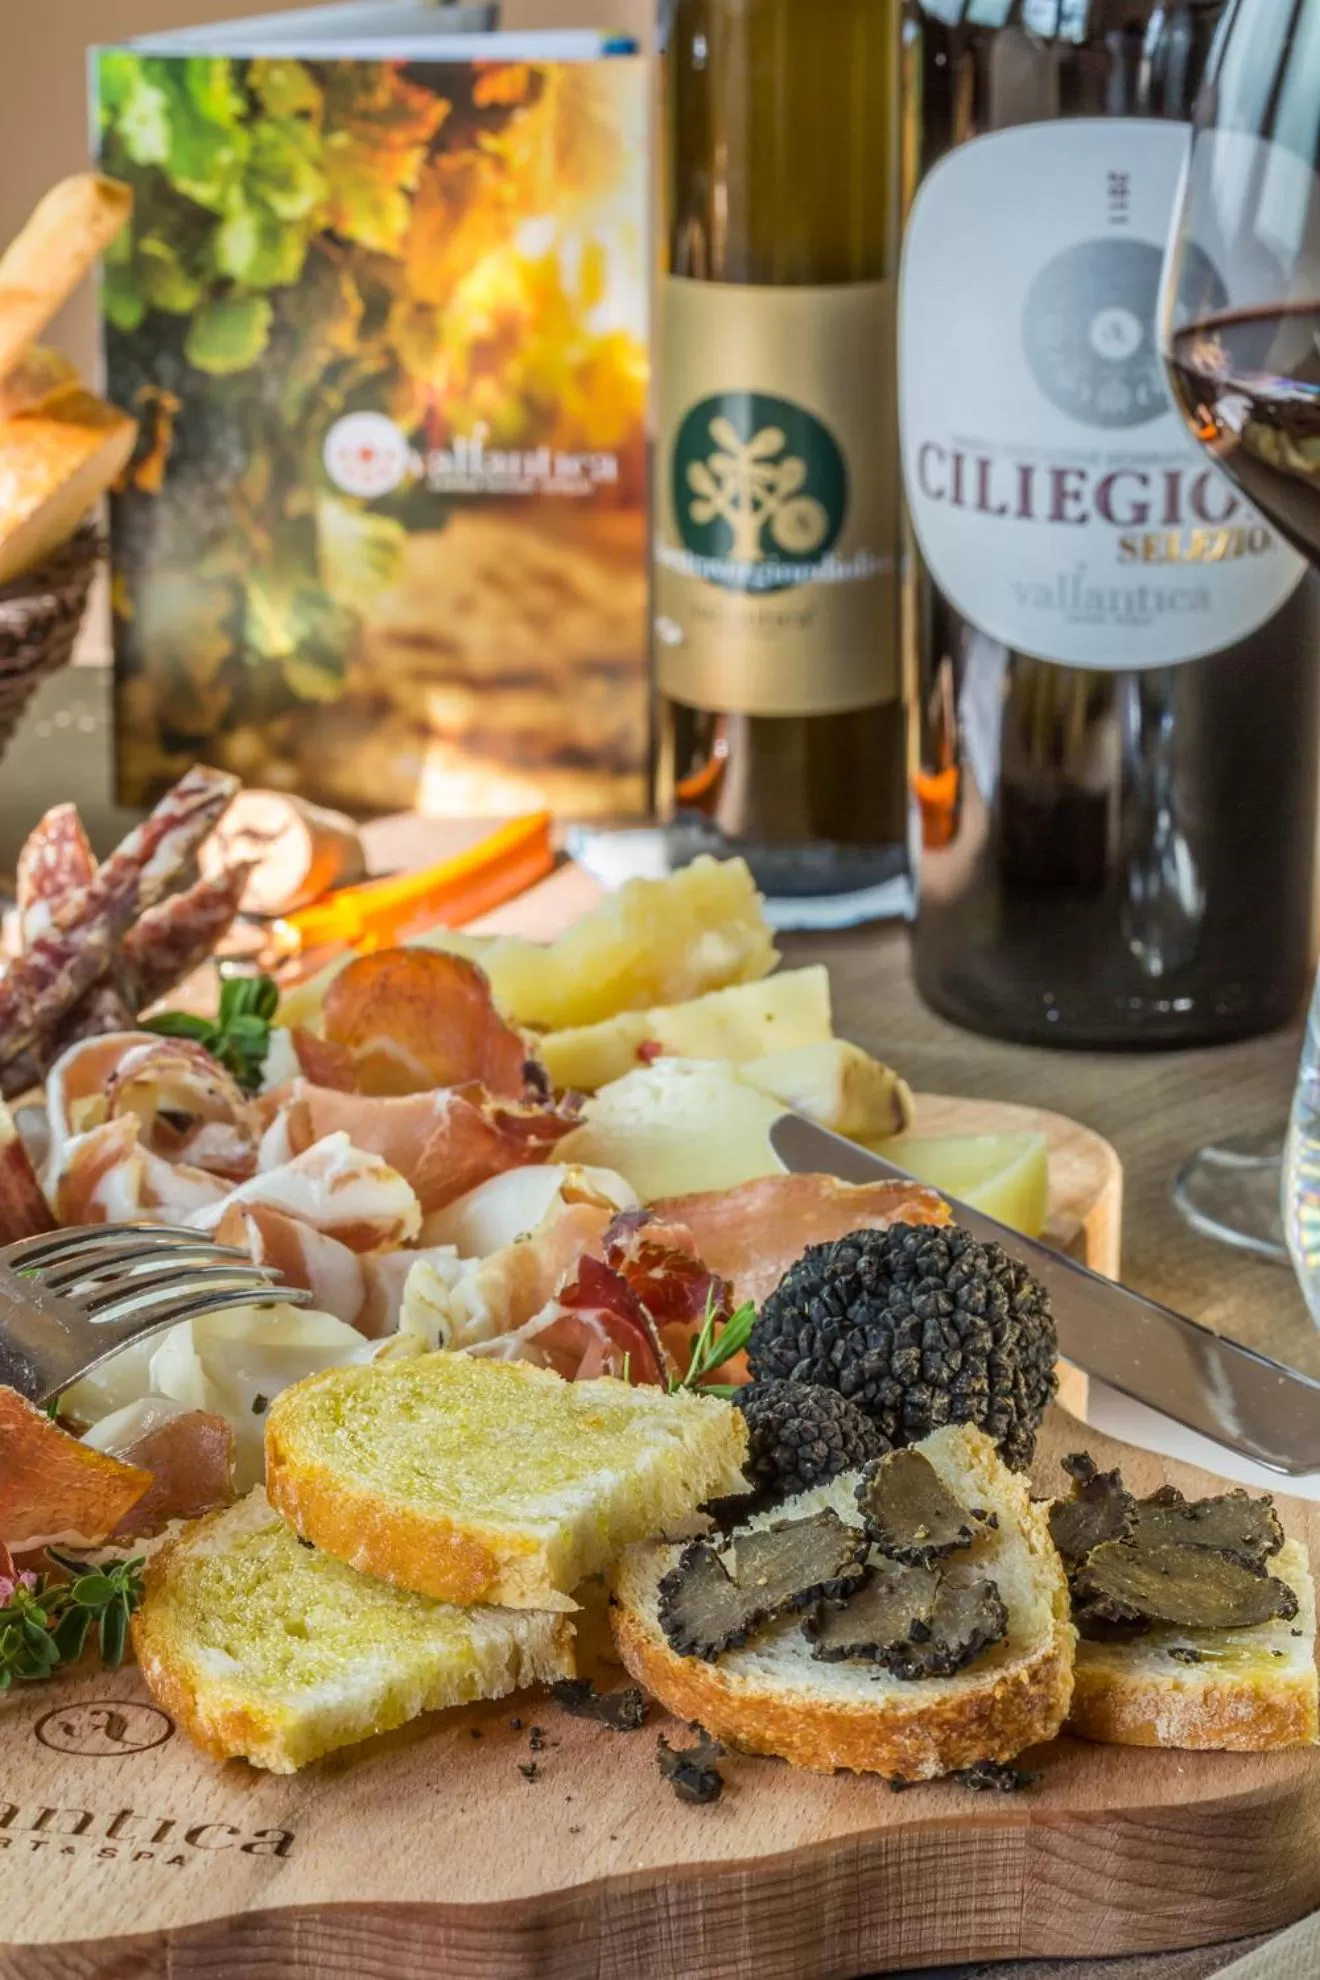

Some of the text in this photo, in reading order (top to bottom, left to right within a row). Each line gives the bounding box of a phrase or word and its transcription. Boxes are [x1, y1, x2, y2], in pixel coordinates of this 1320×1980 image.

[917, 440, 1252, 527] CILIEGIO
[1117, 528, 1274, 565] SELEZIO
[97, 1847, 187, 1867] SPA
